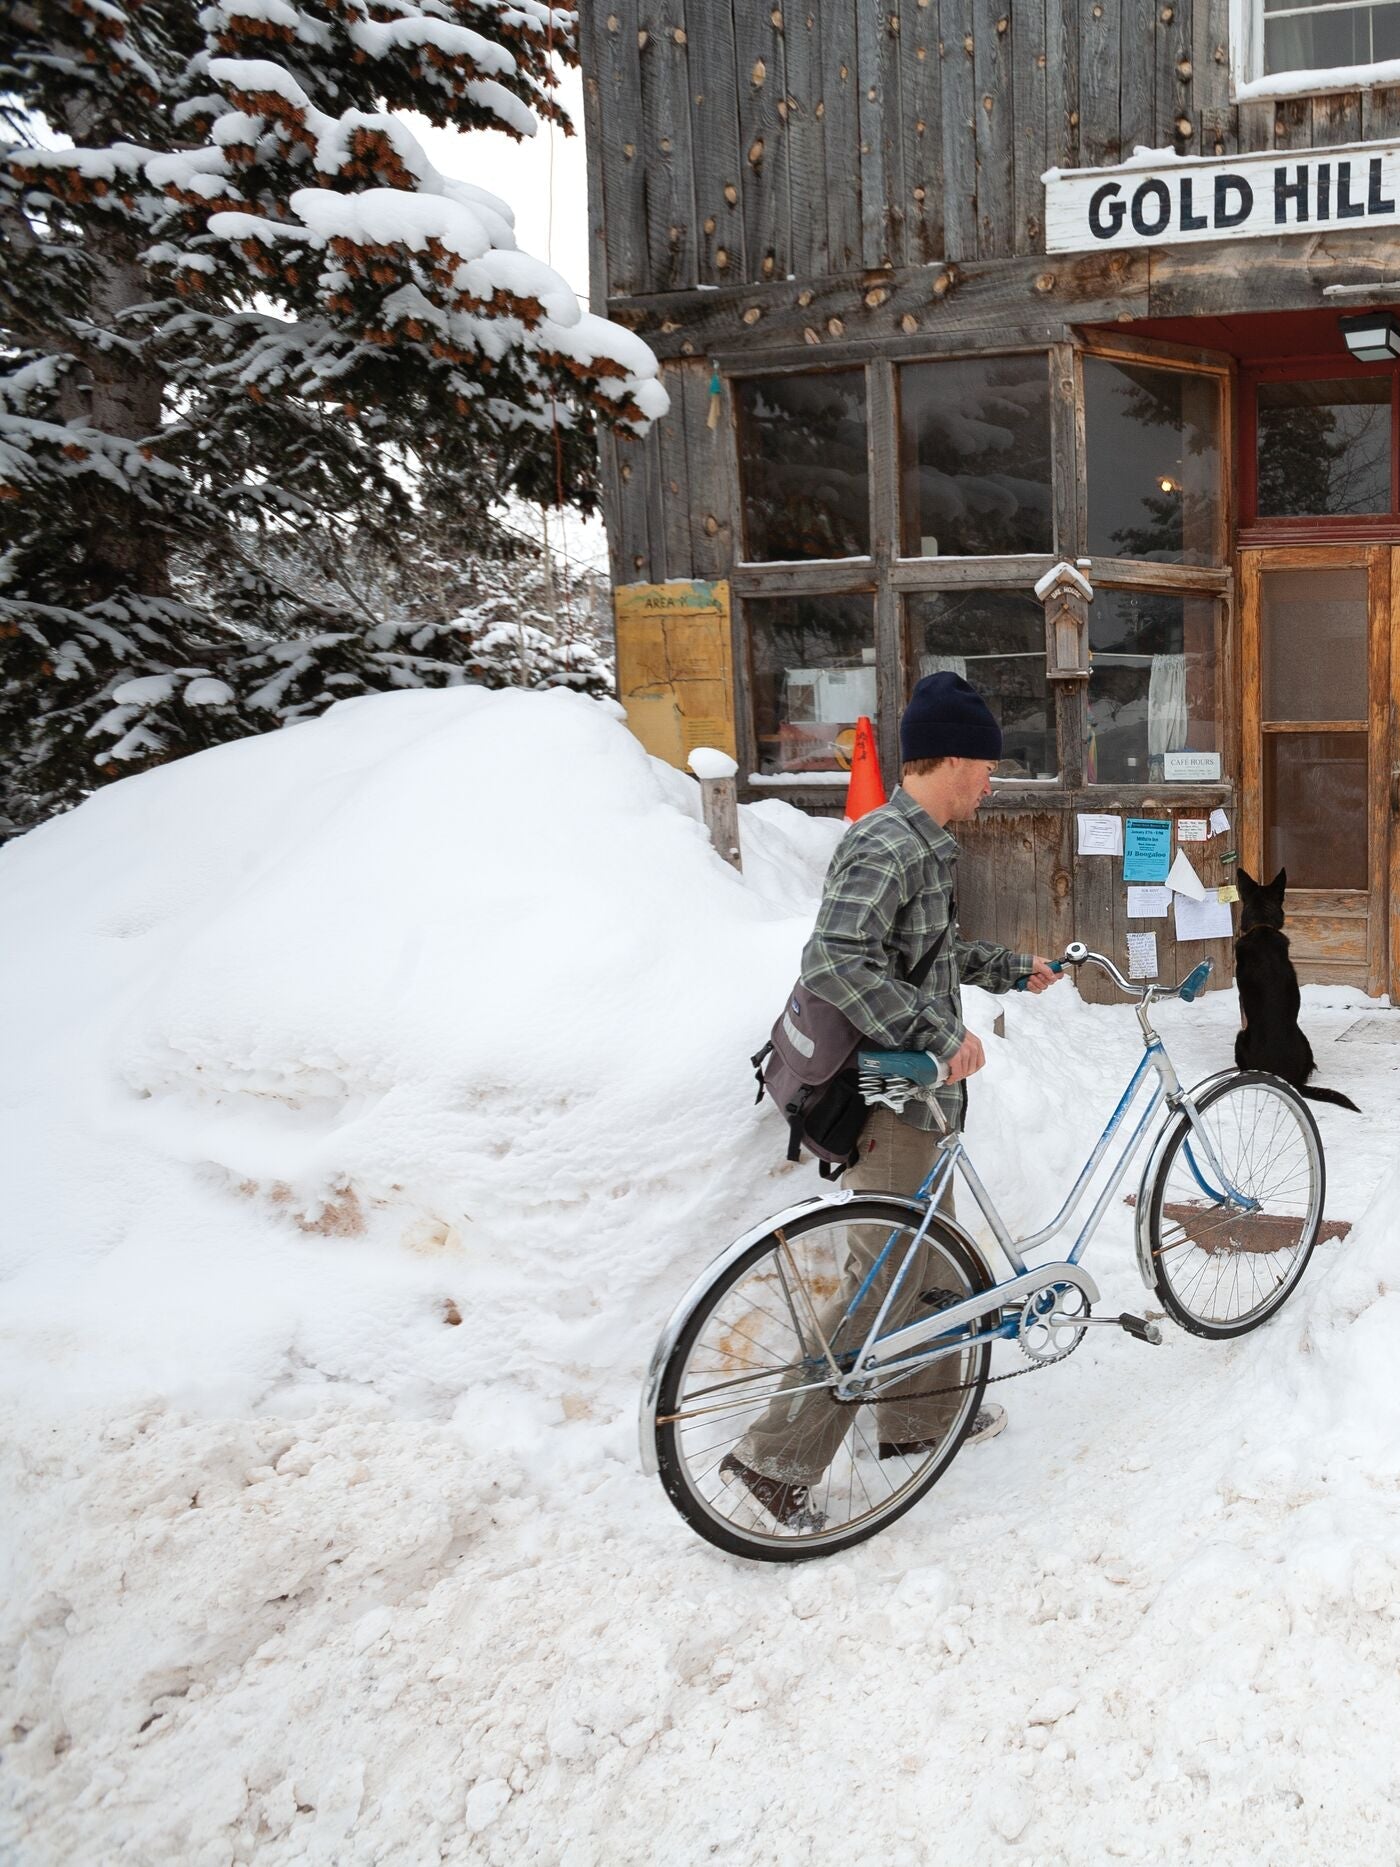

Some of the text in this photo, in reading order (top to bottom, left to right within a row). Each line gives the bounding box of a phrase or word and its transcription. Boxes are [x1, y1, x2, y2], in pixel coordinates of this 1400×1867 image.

[1088, 173, 1254, 240] GOLD
[1273, 157, 1396, 225] HILL
[644, 597, 676, 609] AREA
